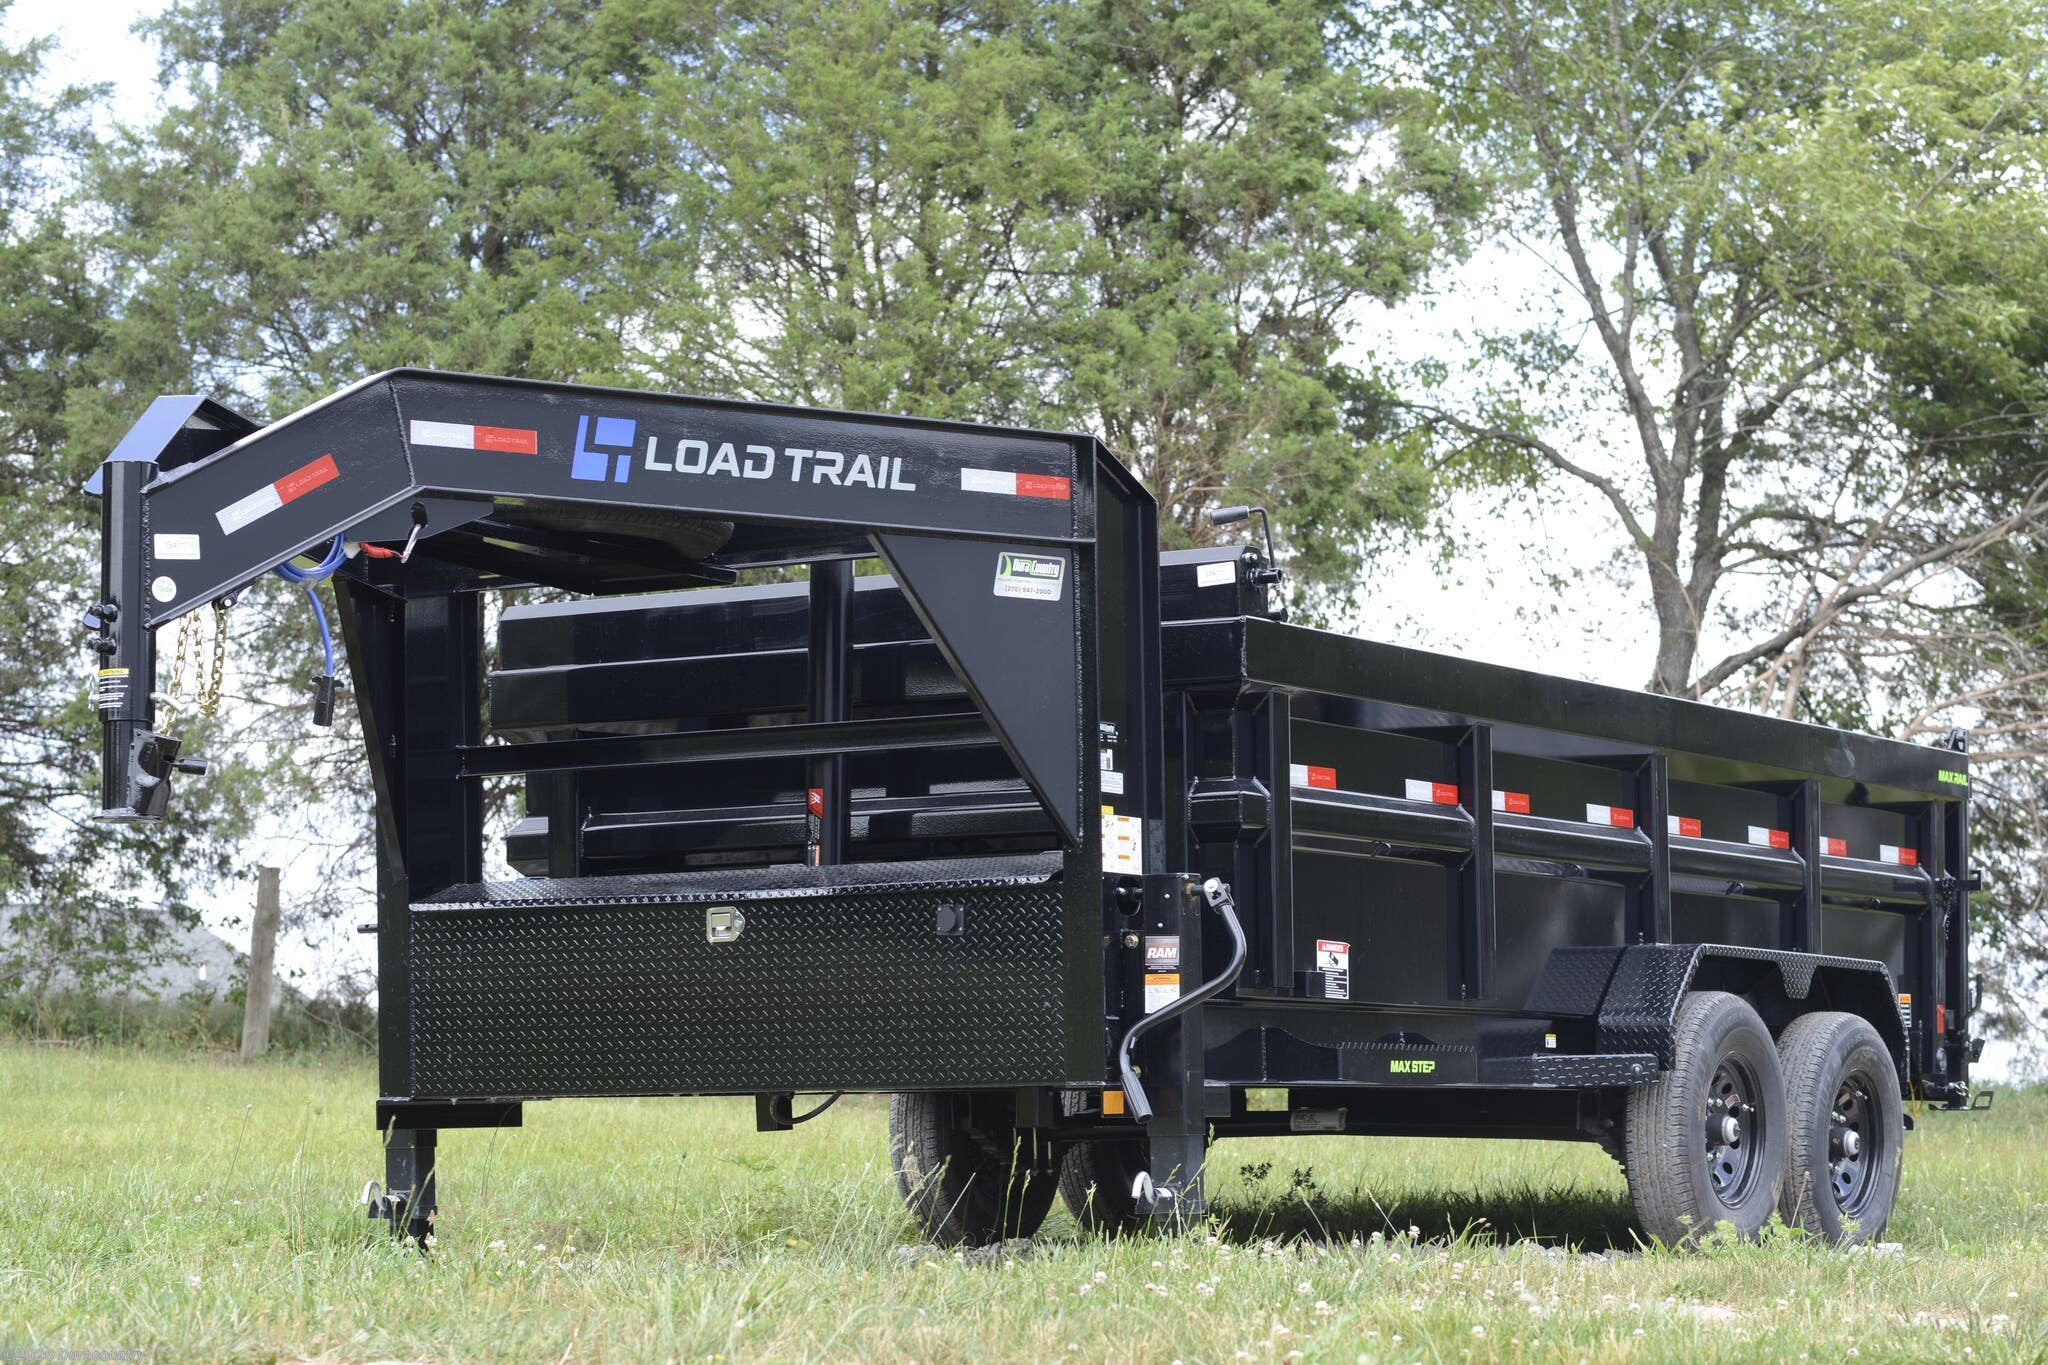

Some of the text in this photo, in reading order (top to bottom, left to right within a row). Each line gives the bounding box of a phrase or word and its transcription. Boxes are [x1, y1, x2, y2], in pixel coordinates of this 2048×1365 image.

[645, 436, 917, 491] LOAD TRAIL
[1013, 558, 1060, 578] Dura Country
[1005, 585, 1021, 593] (270)
[1938, 770, 1969, 787] MAX RAIL
[1147, 947, 1177, 959] RAM
[1390, 1060, 1436, 1073] MAX STEP
